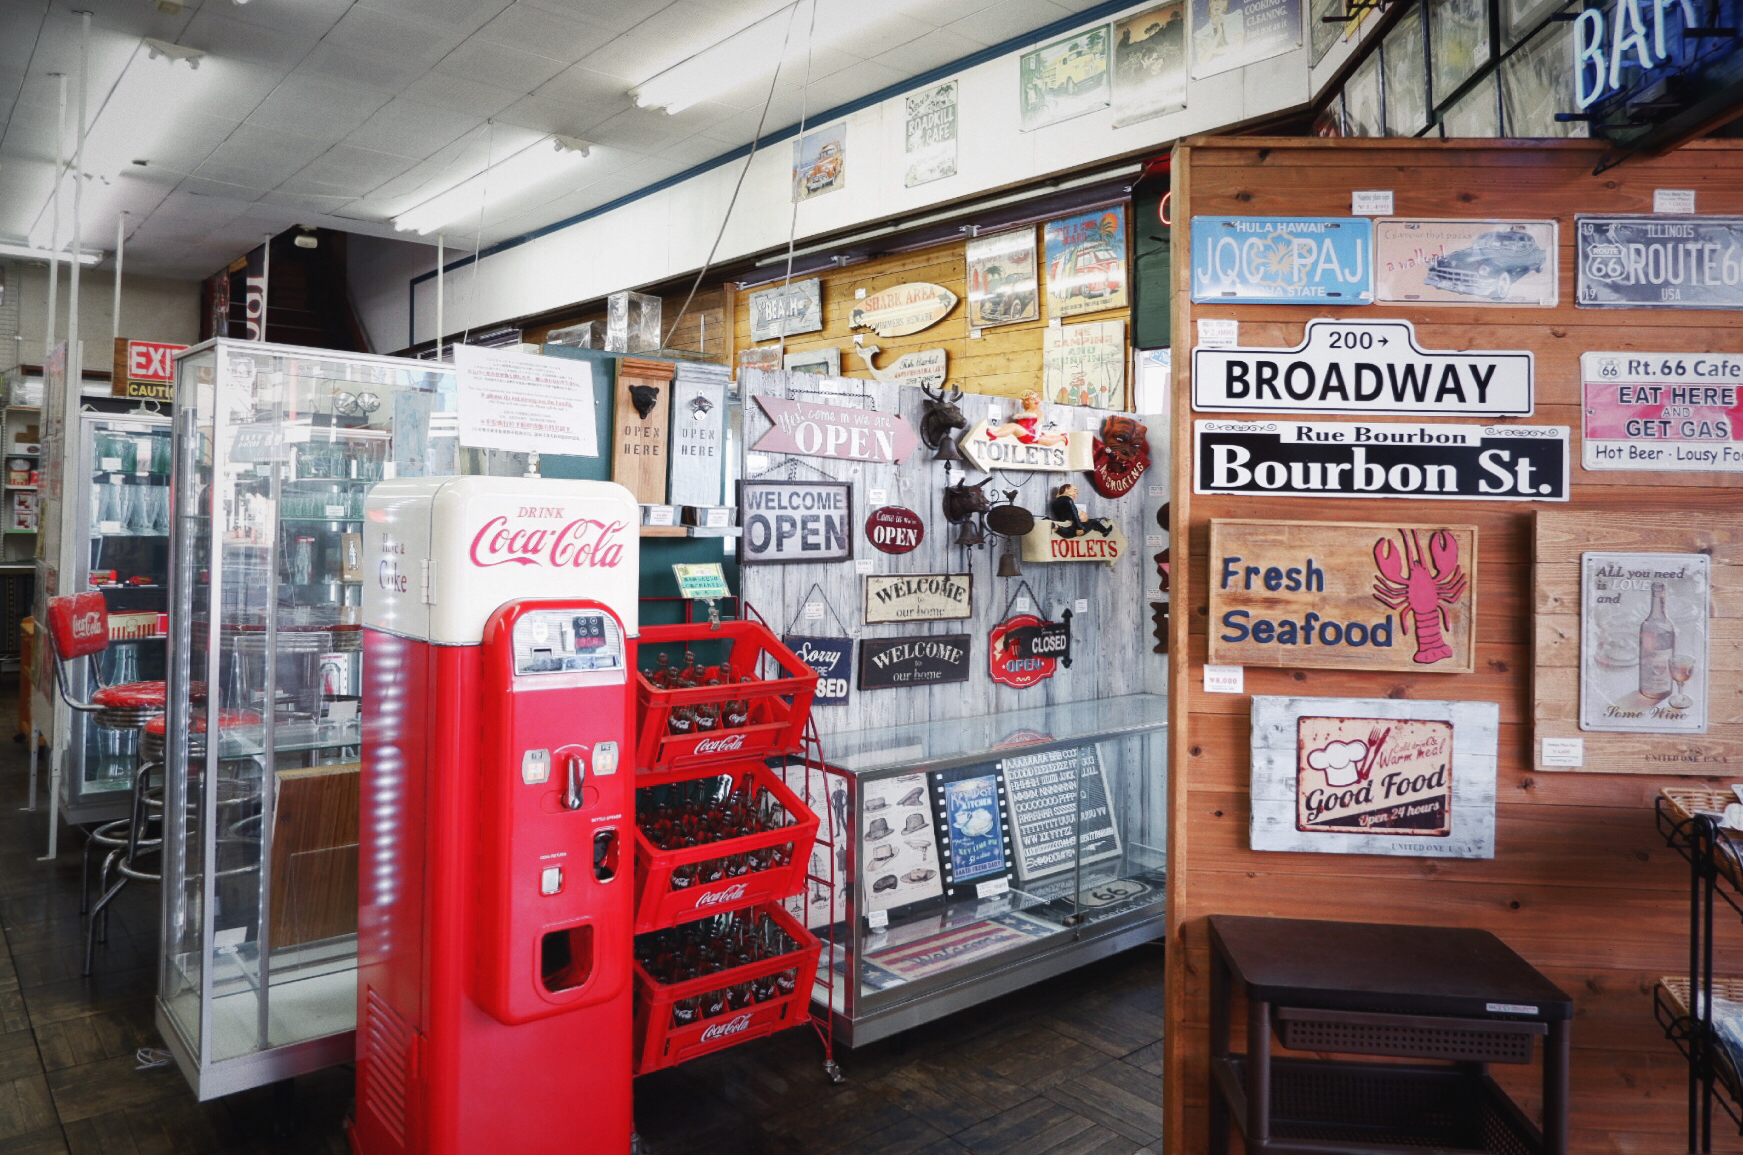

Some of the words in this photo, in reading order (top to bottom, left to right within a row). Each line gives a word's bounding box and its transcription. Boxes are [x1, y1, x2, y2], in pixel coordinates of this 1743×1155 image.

[1236, 221, 1273, 233] HULA
[1277, 222, 1325, 233] HAWAII
[1647, 225, 1694, 238] ILLINOIS
[1593, 247, 1619, 255] ROUTE
[1293, 238, 1363, 284] PAJ
[1592, 258, 1622, 277] 66
[1628, 243, 1743, 286] ROUTE6
[865, 292, 902, 312] SHARK
[906, 286, 936, 304] AREA
[1287, 287, 1326, 297] STATE
[1661, 288, 1681, 300] USA
[1328, 331, 1373, 350] 200
[1628, 359, 1656, 376] Rt.
[1660, 360, 1686, 376] 66
[1225, 359, 1497, 404] BROADWAY
[1619, 386, 1663, 405] EAT
[1671, 387, 1734, 406] HERE
[808, 410, 836, 422] come
[854, 414, 871, 426] we
[874, 416, 891, 428] are
[1662, 407, 1691, 418] AND
[624, 426, 661, 438] OPEN
[682, 428, 716, 440] OPEN
[1295, 425, 1345, 442] Rue
[1354, 426, 1467, 444] Bourbon
[1626, 420, 1672, 437] GET
[1680, 421, 1728, 438] GAS
[624, 444, 660, 456] HERE
[682, 445, 715, 457] HERE
[794, 421, 895, 462] OPEN
[973, 440, 1065, 466] TOILETS
[1595, 445, 1623, 459] Hot
[1629, 445, 1664, 460] Beer
[1676, 446, 1718, 464] Lousy
[1210, 444, 1458, 492] Bourbon
[1478, 449, 1552, 495] St.
[747, 491, 844, 511] WELCOME
[518, 506, 565, 519] DRINK
[470, 515, 630, 568] Coca-Cola
[748, 513, 846, 553] OPEN
[873, 525, 918, 547] OPEN
[1051, 538, 1118, 558] TOILETS
[1221, 556, 1324, 593] Fresh
[1596, 566, 1624, 577] ALL
[1628, 570, 1650, 581] you
[1654, 569, 1685, 579] need
[875, 578, 967, 605] WELCOME
[1597, 580, 1607, 591] is
[1610, 579, 1653, 592] LOVE
[1596, 593, 1621, 604] and
[896, 608, 914, 617] our
[917, 605, 946, 617] home
[1221, 610, 1393, 647] Seafood
[1032, 635, 1067, 653] CLOSED
[796, 641, 842, 672] Sorry
[872, 642, 964, 669] WELCOME
[1006, 658, 1042, 673] OPEN
[893, 673, 911, 682] our
[914, 669, 942, 681] home
[694, 734, 748, 755] Coca-Cola
[1377, 747, 1413, 769] Warm
[1681, 754, 1699, 763] ONE
[1304, 779, 1373, 822] Good
[1381, 763, 1447, 799] Food
[1358, 812, 1388, 827] Open
[1391, 804, 1407, 821] 24
[1407, 801, 1440, 817] hours
[1426, 844, 1445, 852] ONE
[695, 882, 749, 908] Coca-Cola
[1092, 887, 1130, 900] 66
[701, 1012, 755, 1042] Coca-Cola
